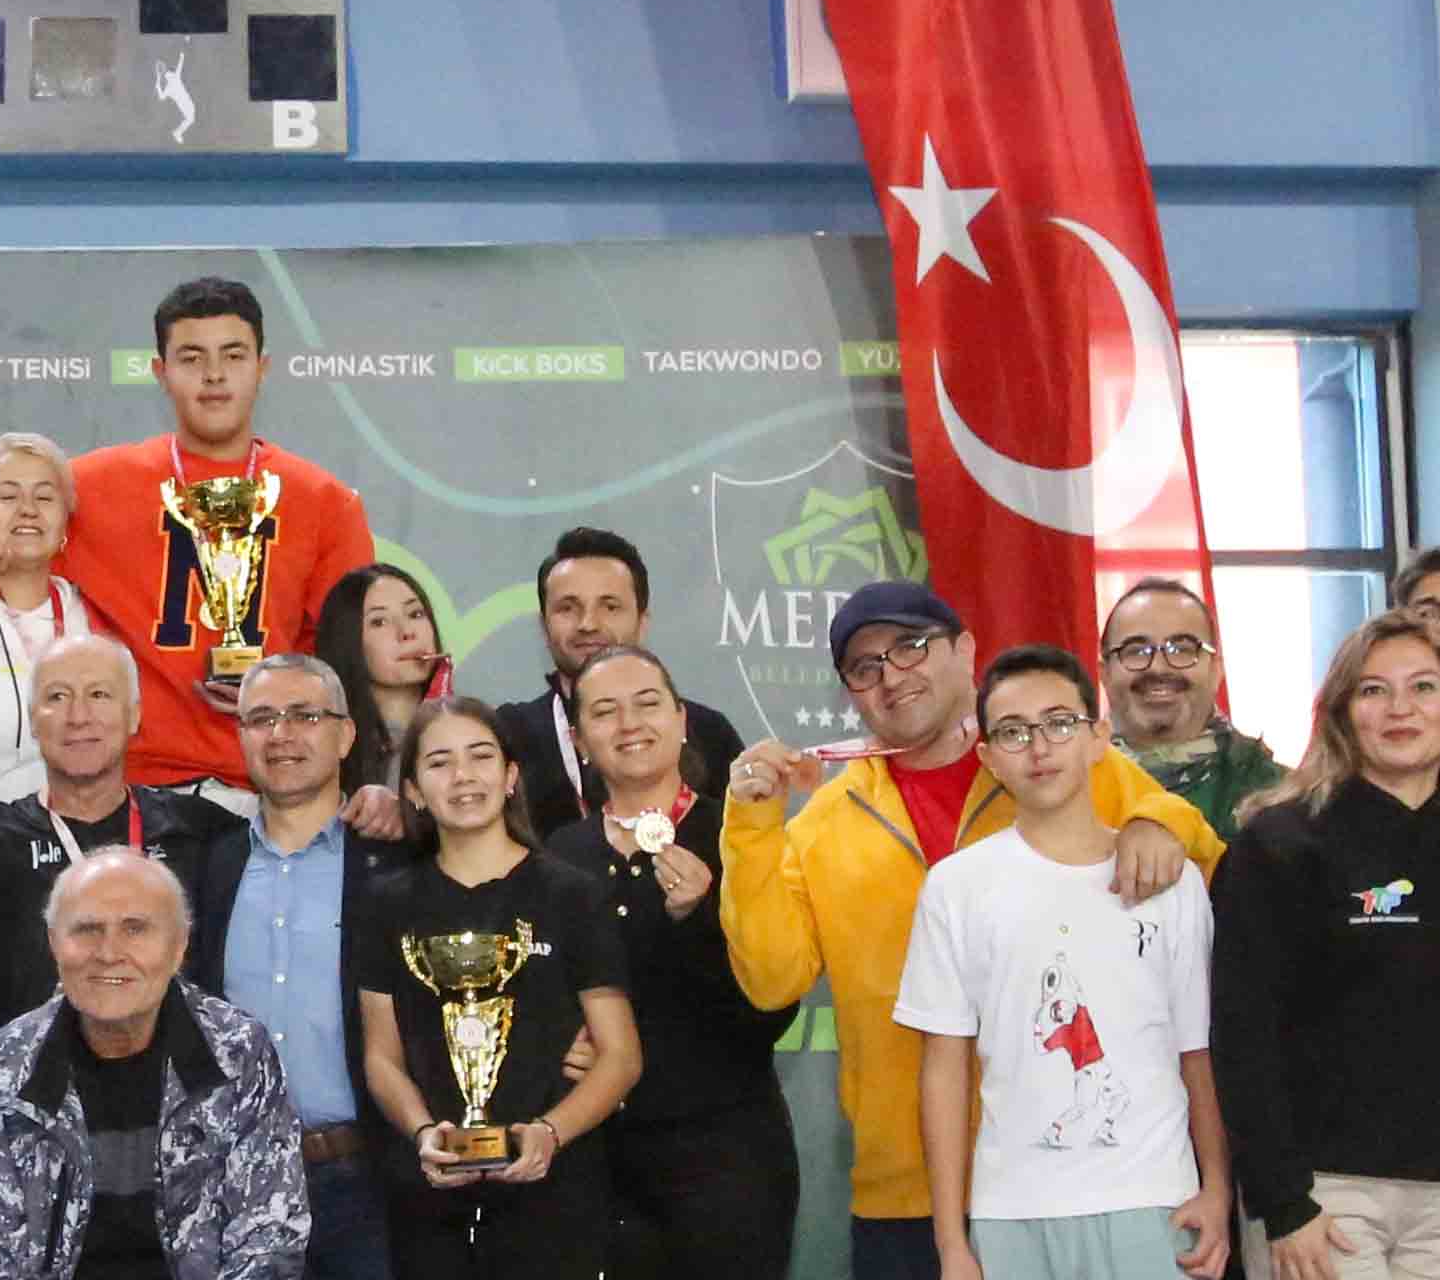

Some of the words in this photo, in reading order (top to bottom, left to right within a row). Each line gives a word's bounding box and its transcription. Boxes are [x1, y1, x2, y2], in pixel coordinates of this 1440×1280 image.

[271, 100, 321, 149] B
[536, 352, 608, 376] BOKS
[642, 348, 823, 373] TAEKWONDO
